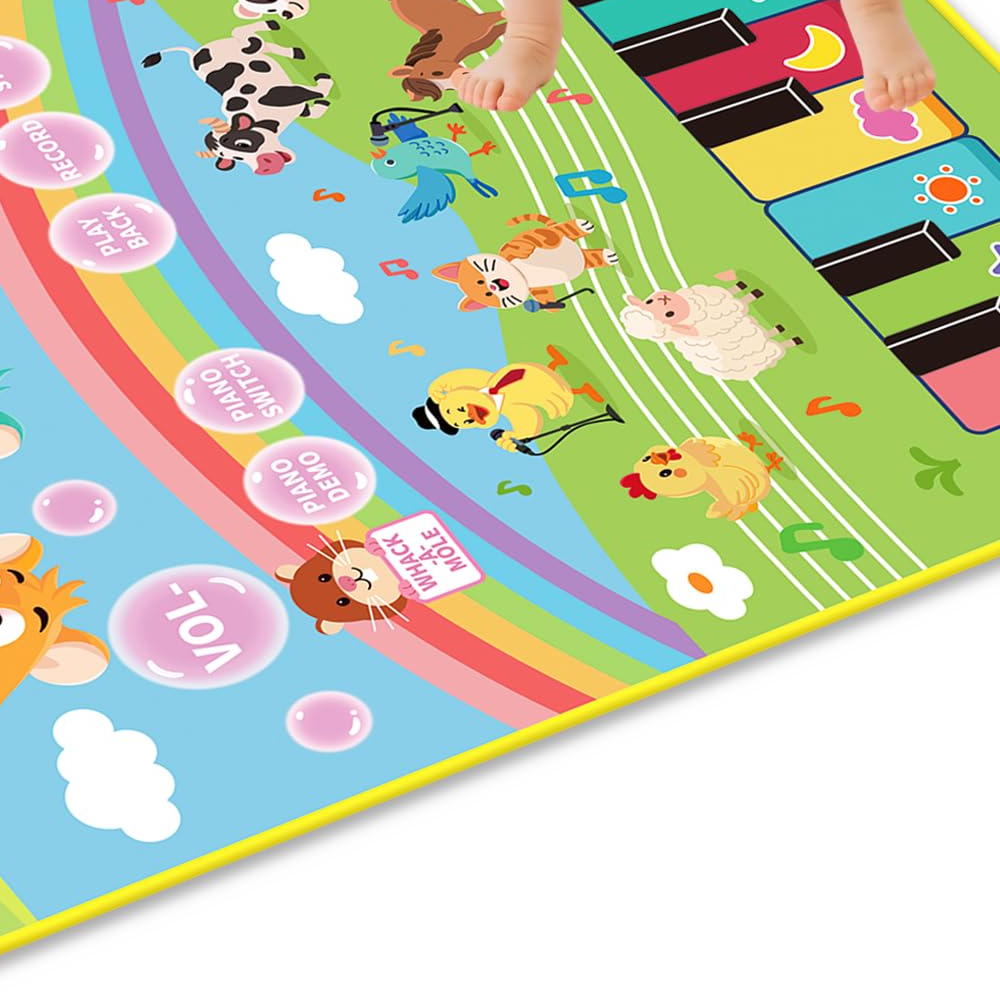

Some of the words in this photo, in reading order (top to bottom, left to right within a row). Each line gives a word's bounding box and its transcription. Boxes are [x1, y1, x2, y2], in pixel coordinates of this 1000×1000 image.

[21, 119, 82, 182] RECORD
[76, 218, 122, 257] PLAY
[101, 206, 150, 250] BACK
[199, 367, 254, 422] PIANO
[219, 353, 284, 419] SWITCH
[270, 458, 326, 514] PIANO
[298, 450, 351, 503] DEMO
[381, 532, 438, 592] WHACK
[420, 526, 467, 573] MOLE
[164, 582, 243, 674] VOL-
